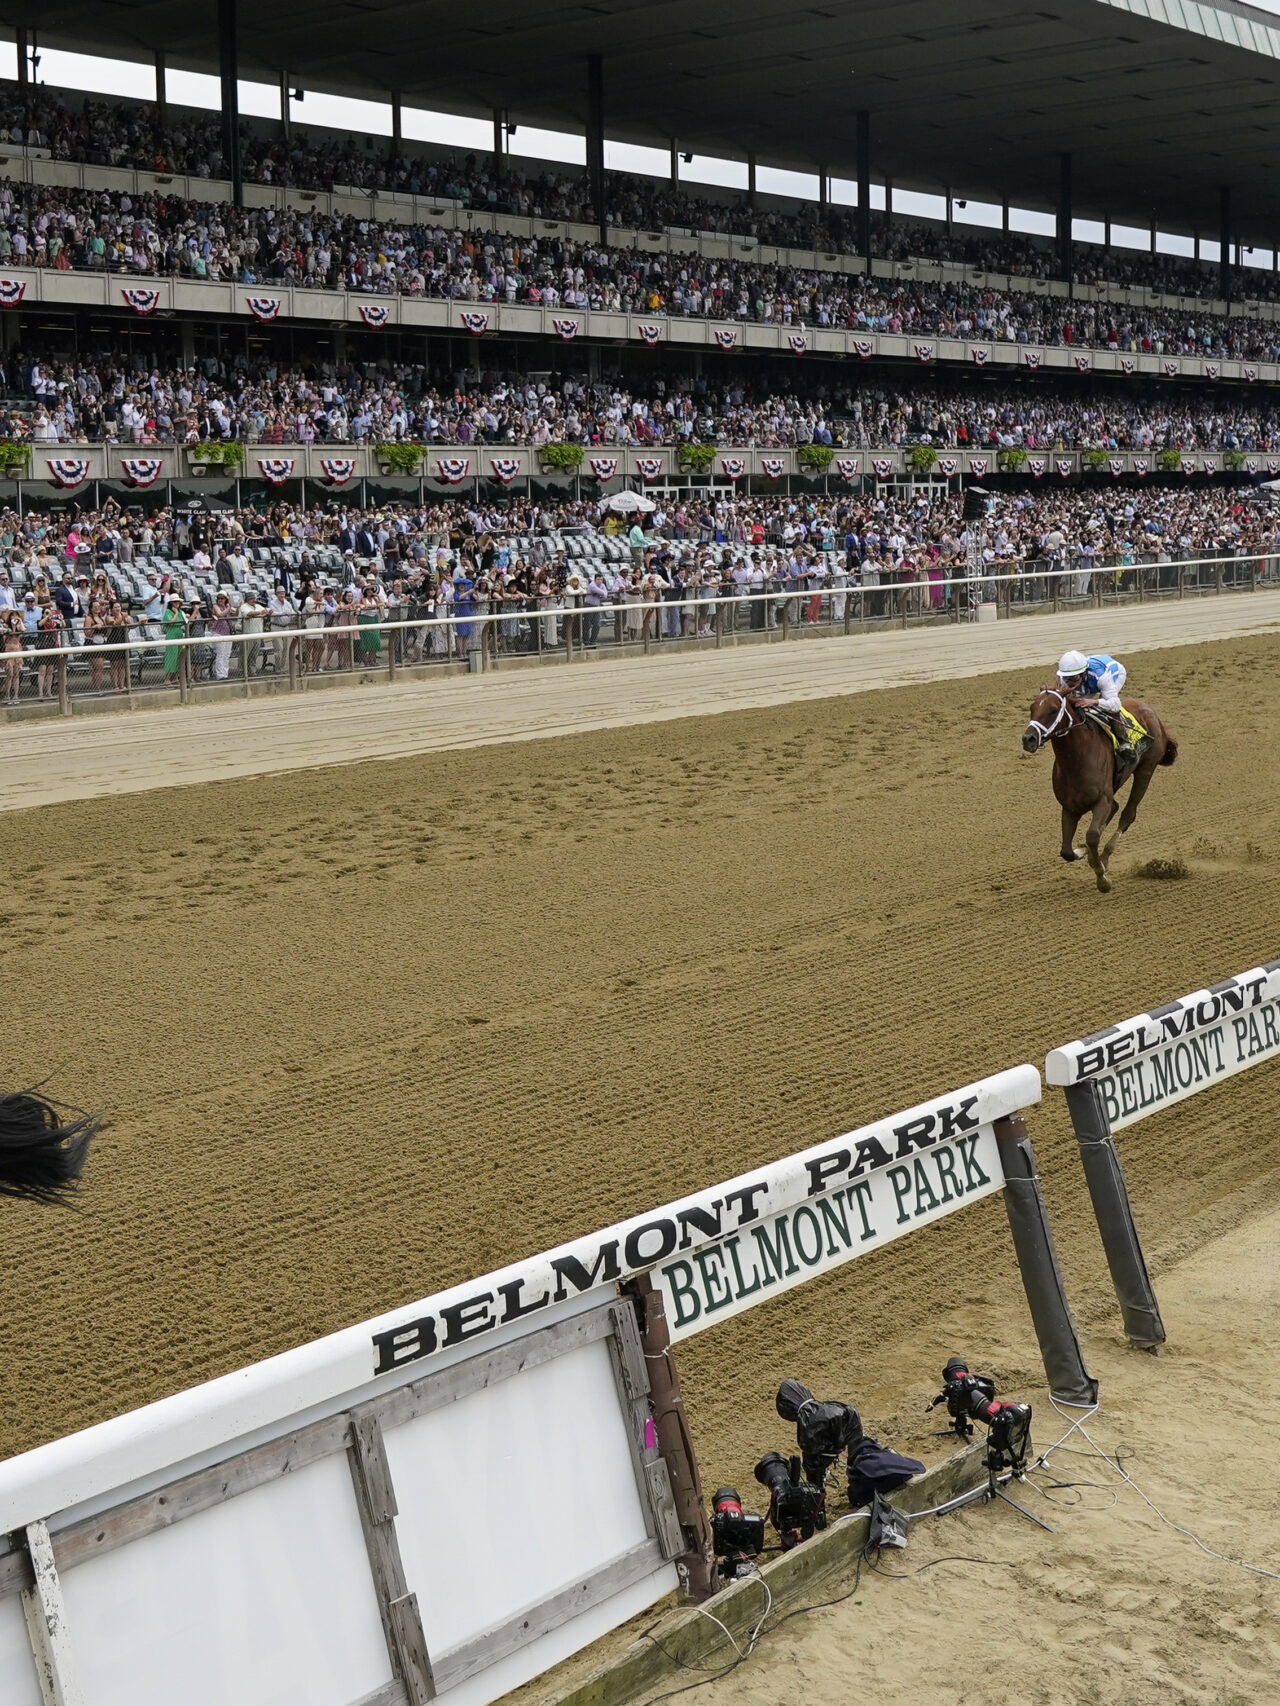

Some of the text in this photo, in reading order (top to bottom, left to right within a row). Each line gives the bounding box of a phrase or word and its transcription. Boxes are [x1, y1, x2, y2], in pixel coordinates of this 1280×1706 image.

[1076, 976, 1268, 1080] BELMONT
[1098, 996, 1280, 1125] BELMONT PAR
[372, 1095, 980, 1376] BELMONT PARK
[661, 1132, 992, 1329] BELMONT PARK
